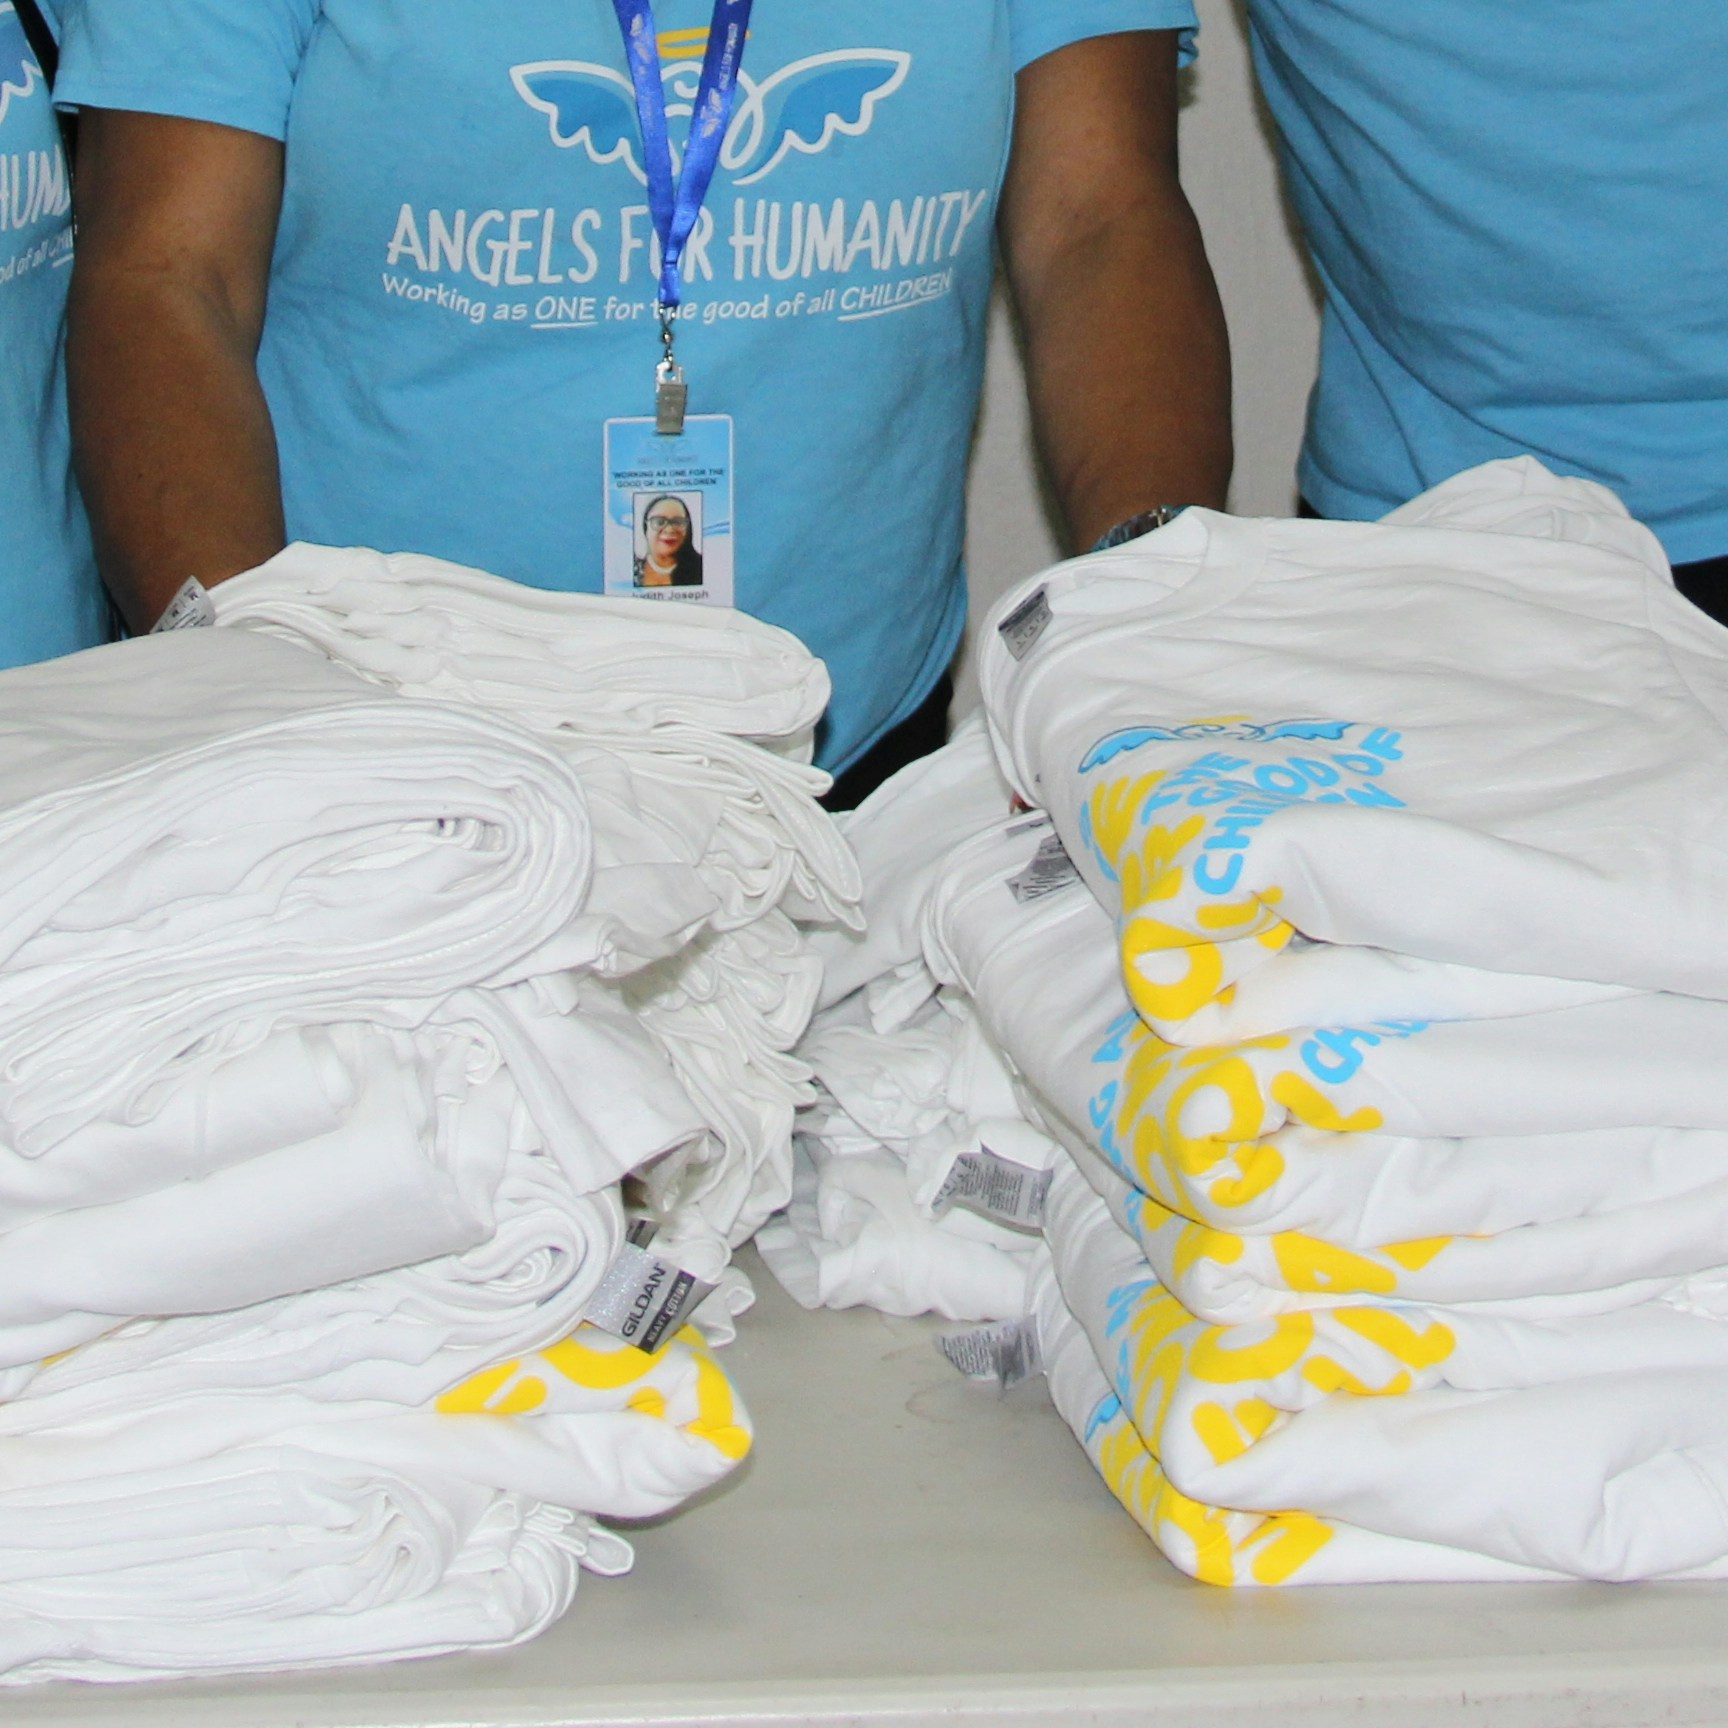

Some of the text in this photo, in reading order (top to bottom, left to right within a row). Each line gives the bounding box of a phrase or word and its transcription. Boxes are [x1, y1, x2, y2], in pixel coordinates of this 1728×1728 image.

[386, 203, 602, 286] ANGELS
[728, 189, 989, 282] HUMANITY
[382, 272, 487, 325] Working
[492, 301, 528, 321] as
[535, 298, 597, 321] ONE
[603, 296, 645, 321] for
[702, 294, 769, 325] good
[775, 289, 804, 318] of
[806, 287, 836, 315] all
[838, 270, 952, 318] CHILDREN
[613, 469, 654, 479] WORKING
[669, 469, 686, 478] ONE
[688, 469, 706, 477] FOR
[709, 468, 724, 476] THE
[616, 478, 716, 488] GOOD OF ALL CHILDREN
[668, 590, 709, 601] Joseph
[622, 1266, 667, 1338] GILDAN
